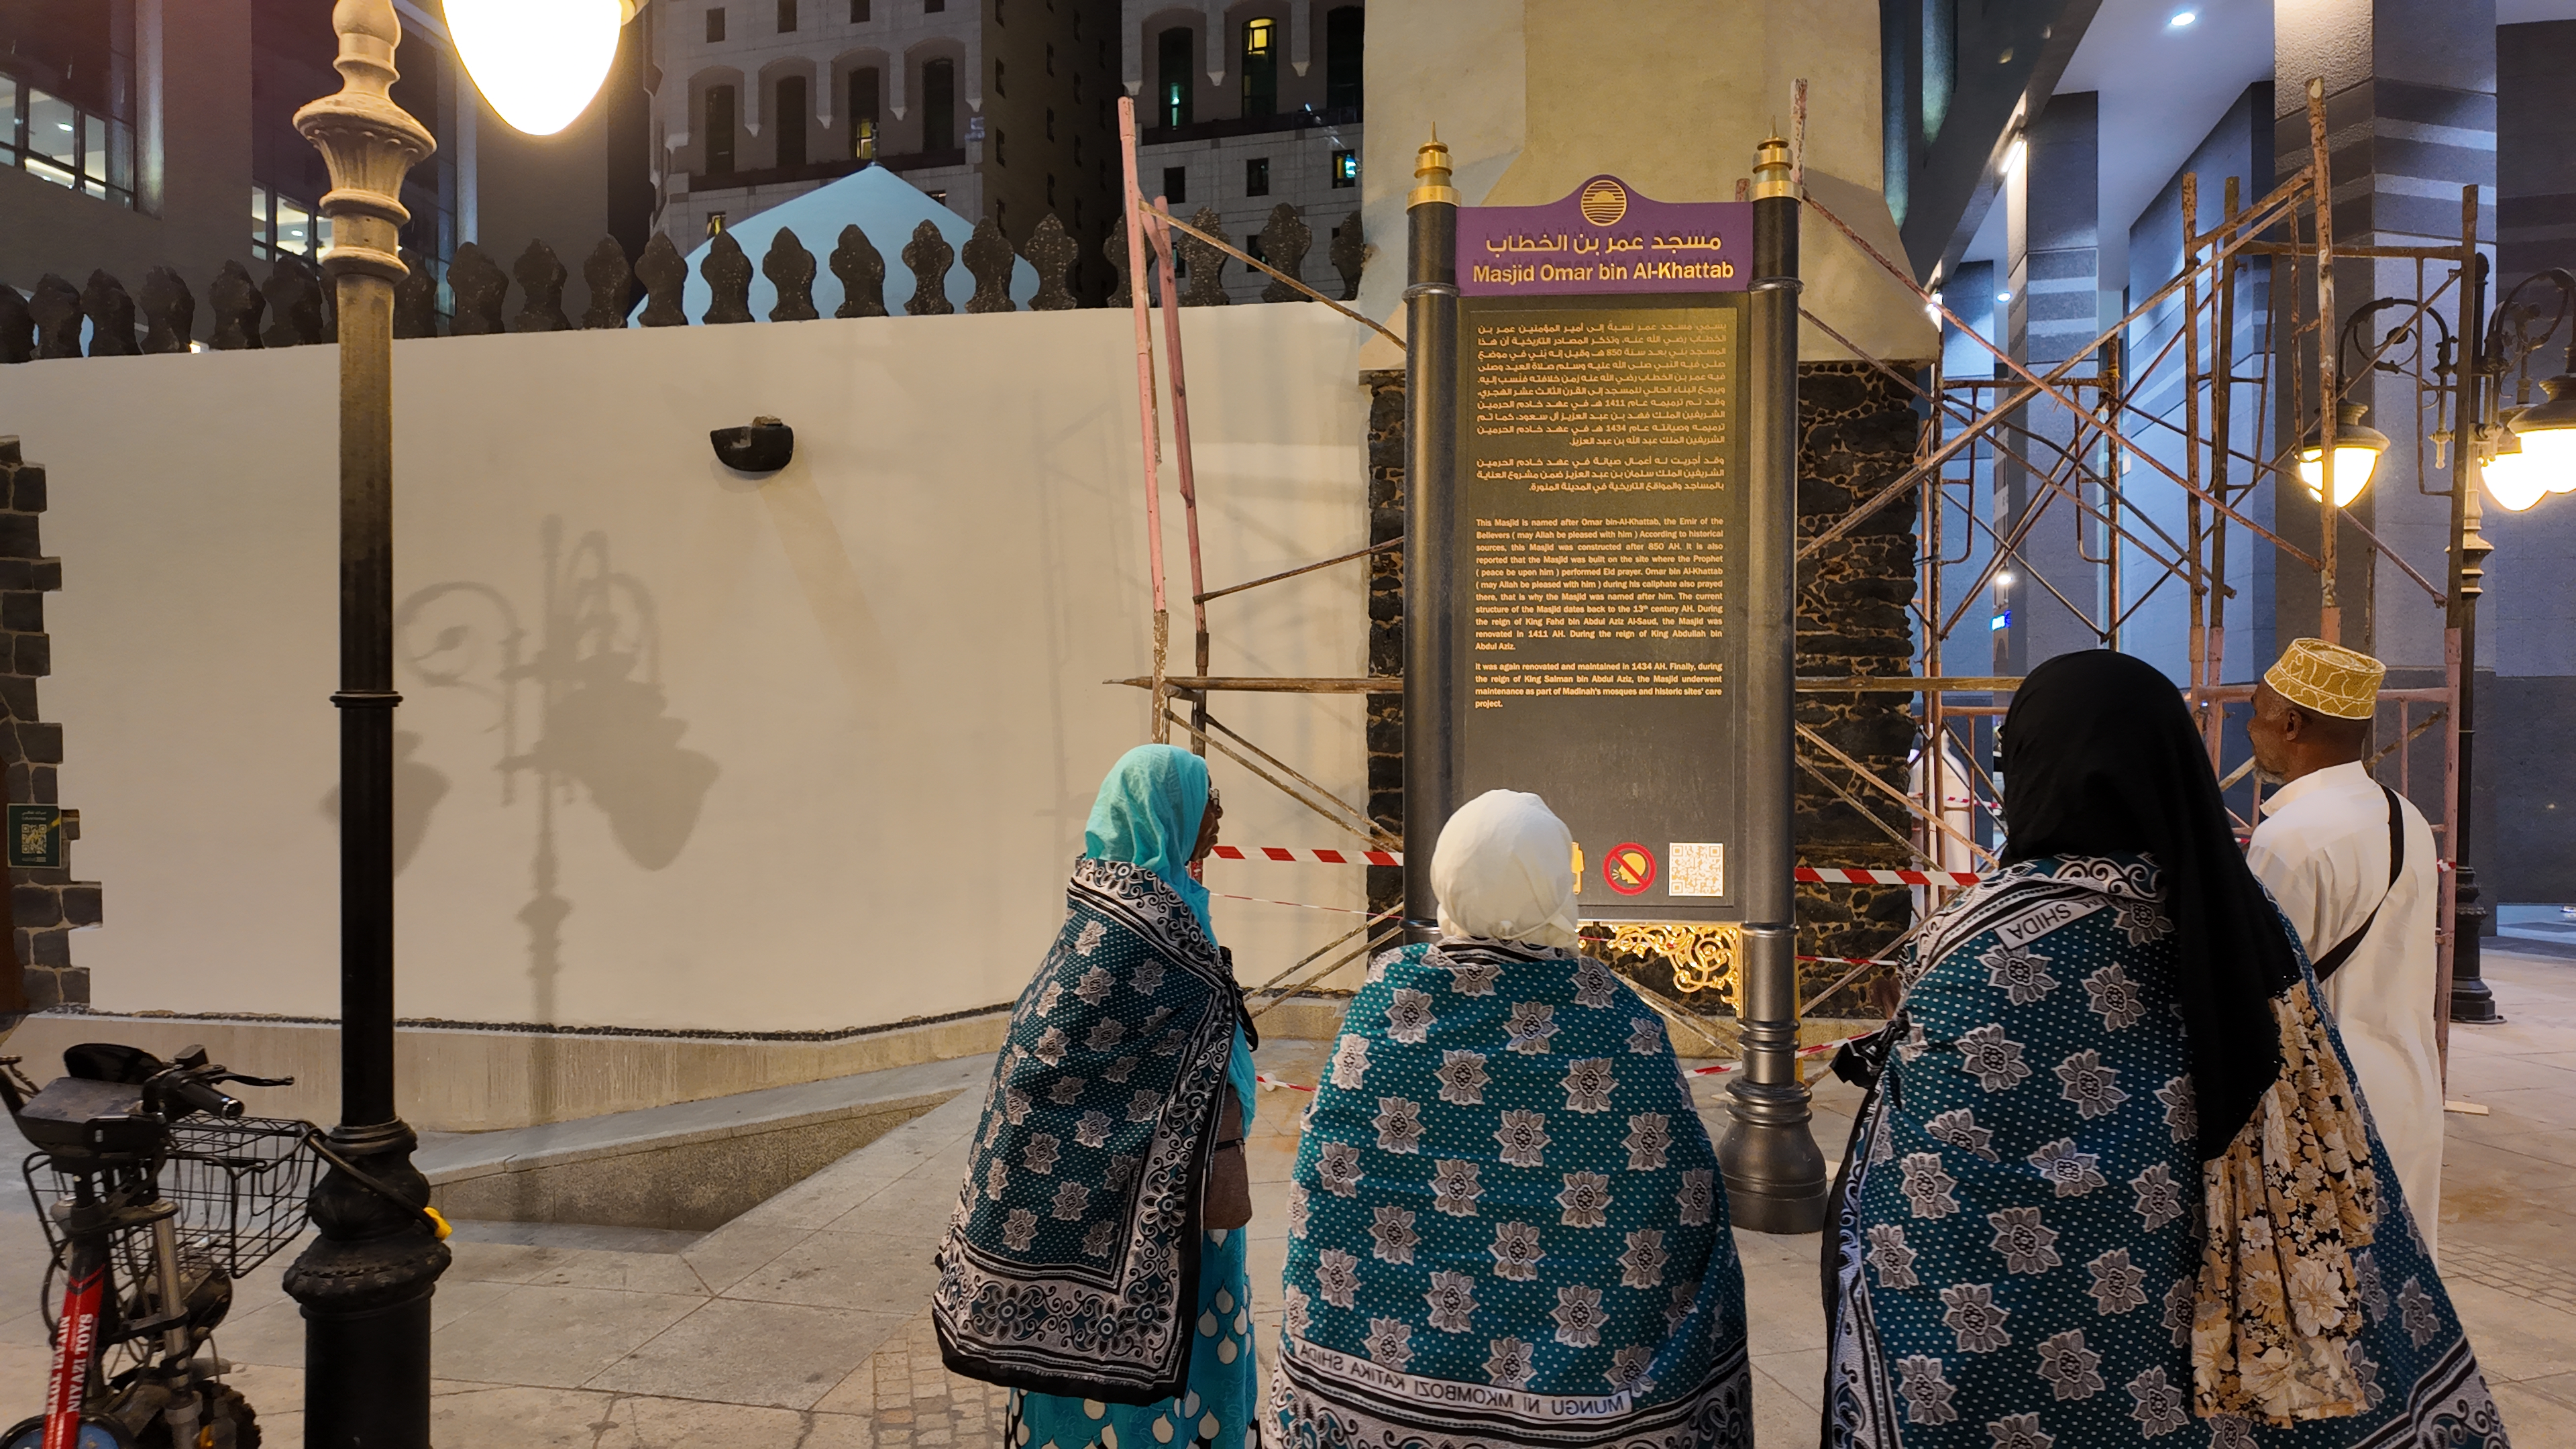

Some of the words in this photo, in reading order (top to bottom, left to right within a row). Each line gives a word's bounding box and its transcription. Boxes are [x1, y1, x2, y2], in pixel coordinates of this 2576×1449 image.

[1485, 234, 1568, 258] الخطاب
[1572, 234, 1601, 256] بن
[1606, 235, 1644, 254] عمر
[1650, 235, 1722, 254] مسجد
[1473, 265, 1535, 286] Masjid
[1540, 264, 1594, 282] Omar
[1599, 263, 1627, 280] bin
[1633, 261, 1734, 280] Al-Khattab
[1495, 519, 1519, 527] Masjid
[1605, 518, 1661, 526] bin-Al-Khattab,
[1529, 543, 1554, 552] Masjid
[1477, 556, 1507, 565] reported
[1544, 556, 1568, 565] Masjid
[1693, 555, 1723, 564] Prophet
[1528, 593, 1543, 602] why
[1562, 593, 1586, 602] Masjid
[1492, 618, 1510, 627] reign
[1525, 618, 1542, 627] King
[1627, 617, 1658, 625] Al-Saud,
[1679, 617, 1703, 627] Masjid
[1570, 630, 1595, 639] During
[1616, 630, 1635, 639] reign
[1651, 630, 1668, 639] King
[1499, 663, 1520, 672] again
[1670, 663, 1696, 672] Finally,
[1698, 663, 1723, 672] during
[1491, 676, 1509, 684] reign
[1524, 676, 1542, 684] King
[1617, 675, 1633, 683] Aziz,
[1654, 675, 1678, 684] Masjid
[1536, 688, 1552, 696] part
[1475, 700, 1503, 708] project.
[2006, 904, 2072, 941] SHIDA
[74, 1313, 93, 1355] TOYS
[66, 1358, 87, 1413] NIYAZI
